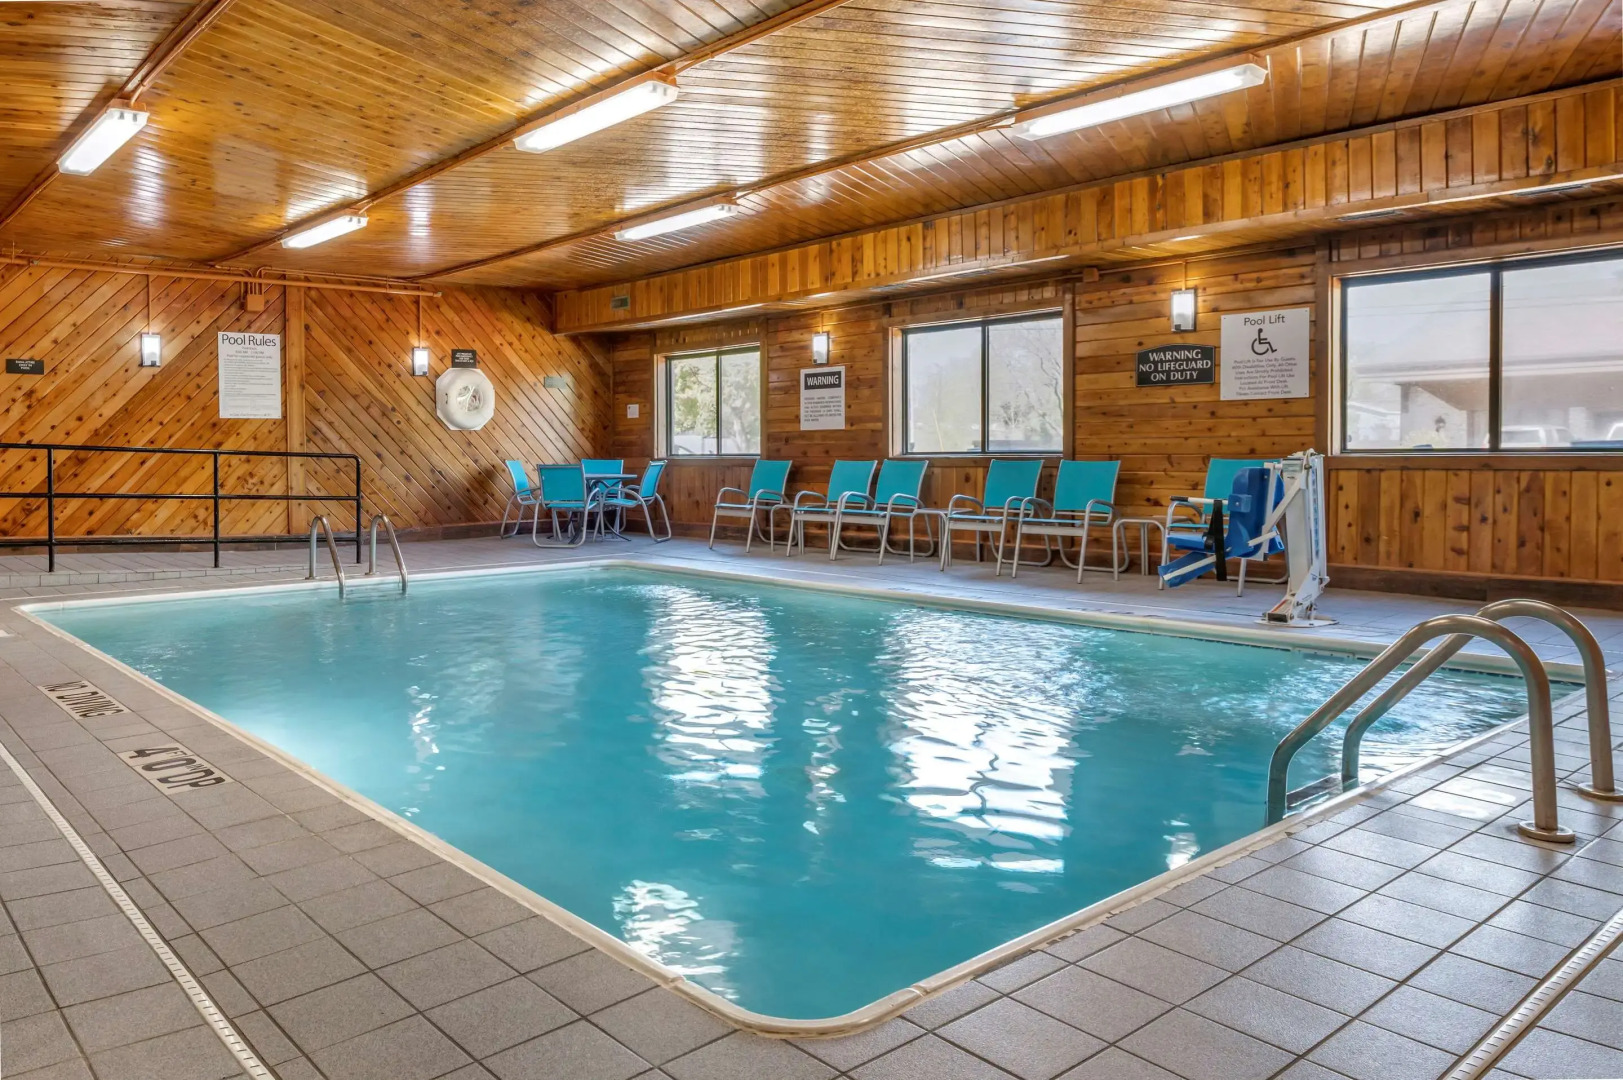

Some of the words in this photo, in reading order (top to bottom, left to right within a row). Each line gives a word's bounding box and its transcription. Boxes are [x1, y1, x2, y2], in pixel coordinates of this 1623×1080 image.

[1243, 316, 1266, 326] Pool
[1268, 314, 1286, 324] Lift
[222, 334, 246, 346] Pool
[248, 335, 276, 346] Rules
[1148, 349, 1202, 362] WARNING
[1139, 364, 1154, 372] NO
[1158, 360, 1211, 370] LIFEGUARD
[806, 376, 838, 386] WARNING
[1150, 372, 1166, 382] ON
[1170, 370, 1198, 380] DUTY
[42, 680, 88, 692] NO
[56, 691, 124, 718] DIVING
[128, 746, 180, 759] 4
[156, 768, 226, 789] DP
